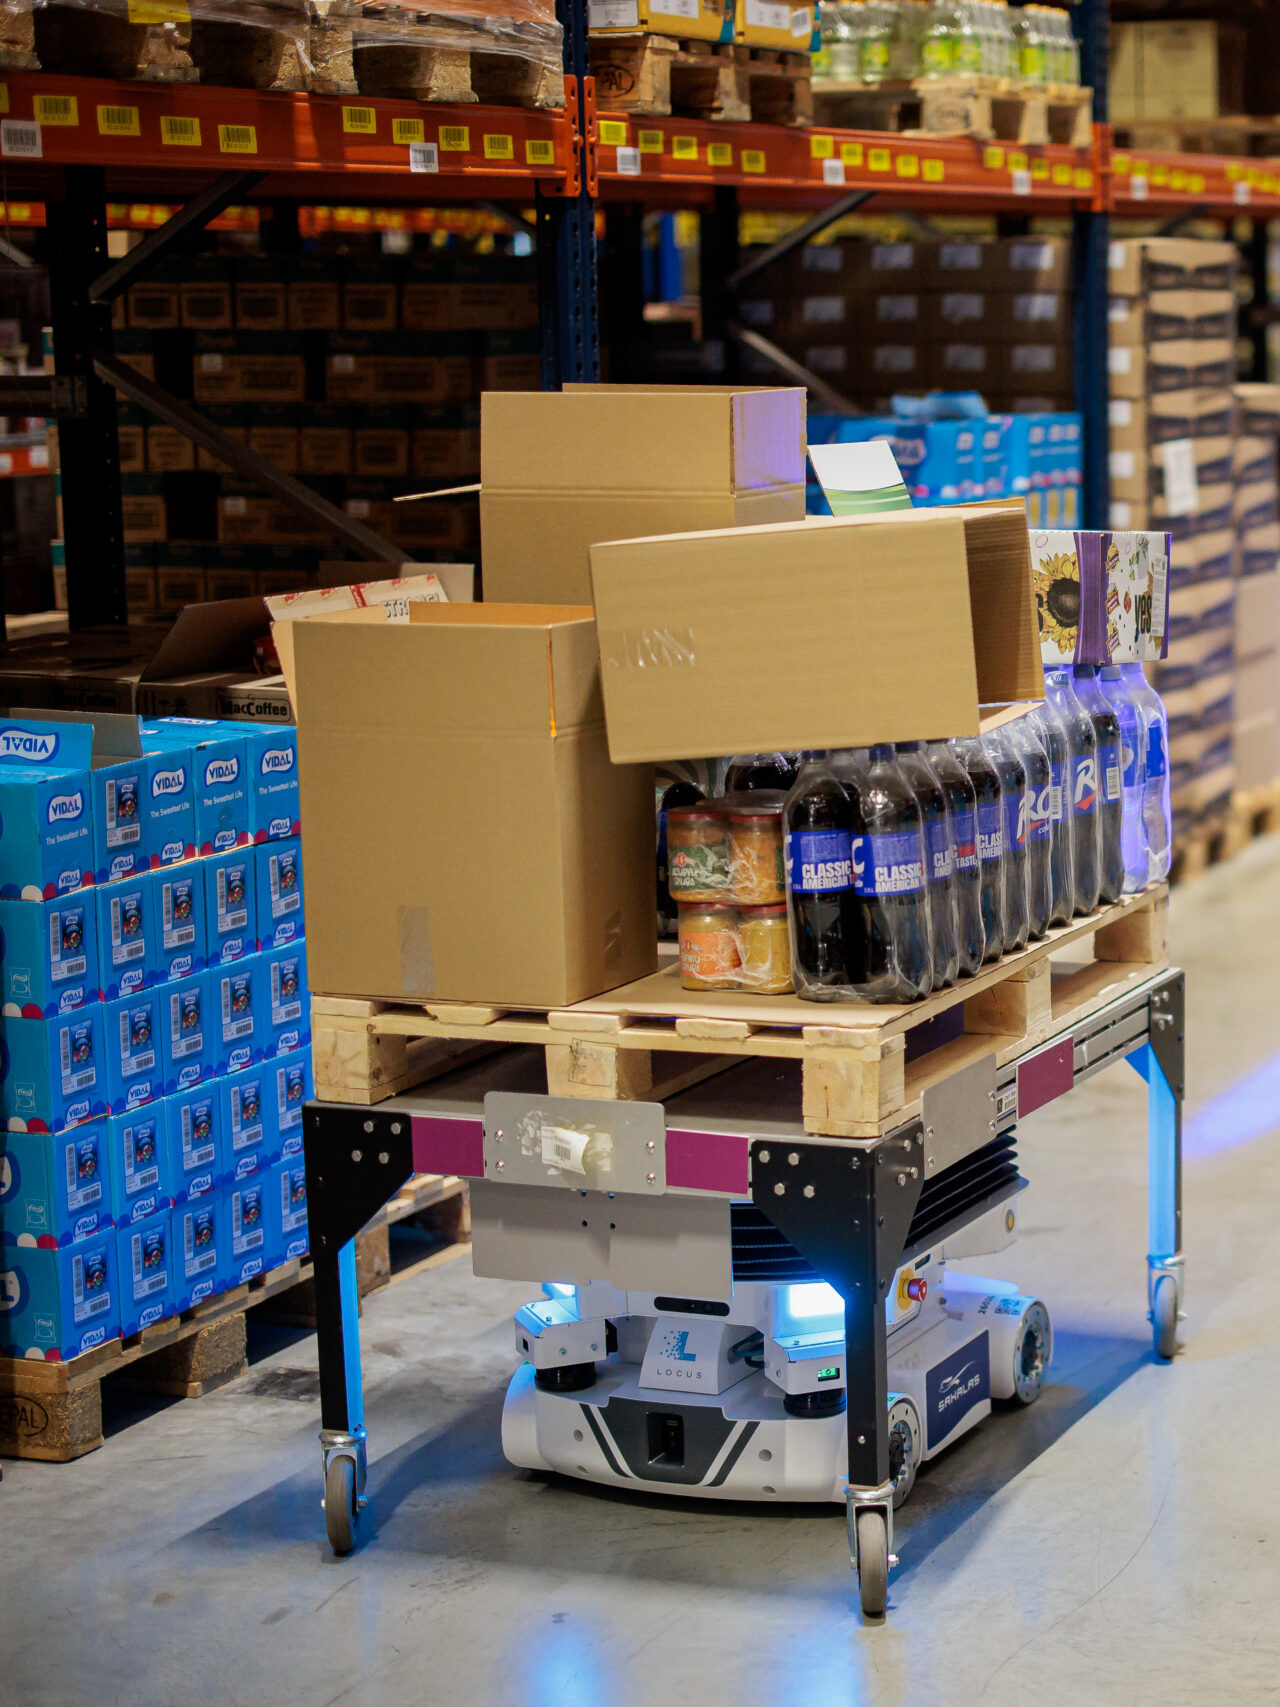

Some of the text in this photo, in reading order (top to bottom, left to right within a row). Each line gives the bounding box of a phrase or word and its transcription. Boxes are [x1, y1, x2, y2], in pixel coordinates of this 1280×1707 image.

[220, 699, 288, 716] MacCoffee
[2, 736, 50, 754] VIDAL
[264, 752, 292, 769] VIDAL
[208, 762, 236, 780] VIDAL
[154, 776, 183, 792] VIDAL
[51, 798, 81, 817] VIDAL
[271, 821, 289, 834] VIDAL
[217, 833, 235, 845] VIDAL
[164, 845, 182, 858] VIDAL
[113, 857, 133, 871] VIDAL
[802, 860, 850, 879] CLASSIC
[874, 862, 922, 882] CLASSIC
[60, 873, 79, 886] VIDAL
[802, 875, 849, 890] AMERICAN
[874, 878, 921, 893] AMERICAN
[277, 925, 294, 937] VIDAL
[224, 941, 241, 954] VIDAL
[172, 959, 190, 971] VIDAL
[123, 973, 142, 986] VIDAL
[62, 991, 82, 1004] VIDAL
[280, 1034, 298, 1046] VIDAL
[231, 1051, 249, 1063] VIDAL
[181, 1067, 199, 1080] VIDAL
[130, 1086, 149, 1099] VIDAL
[68, 1105, 88, 1118] VIDAL
[284, 1141, 301, 1153] VIDAL
[238, 1160, 256, 1172] VIDAL
[191, 1179, 211, 1192] VIDAL
[134, 1203, 154, 1216] VIDAL
[76, 1220, 97, 1233] VIDAL
[288, 1243, 306, 1255] VIDAL
[242, 1264, 261, 1277] VIDAL
[194, 1285, 213, 1298] VIDAL
[141, 1309, 162, 1323] VIDAL
[82, 1332, 104, 1346] VIDAL
[656, 1368, 702, 1379] LOCUS
